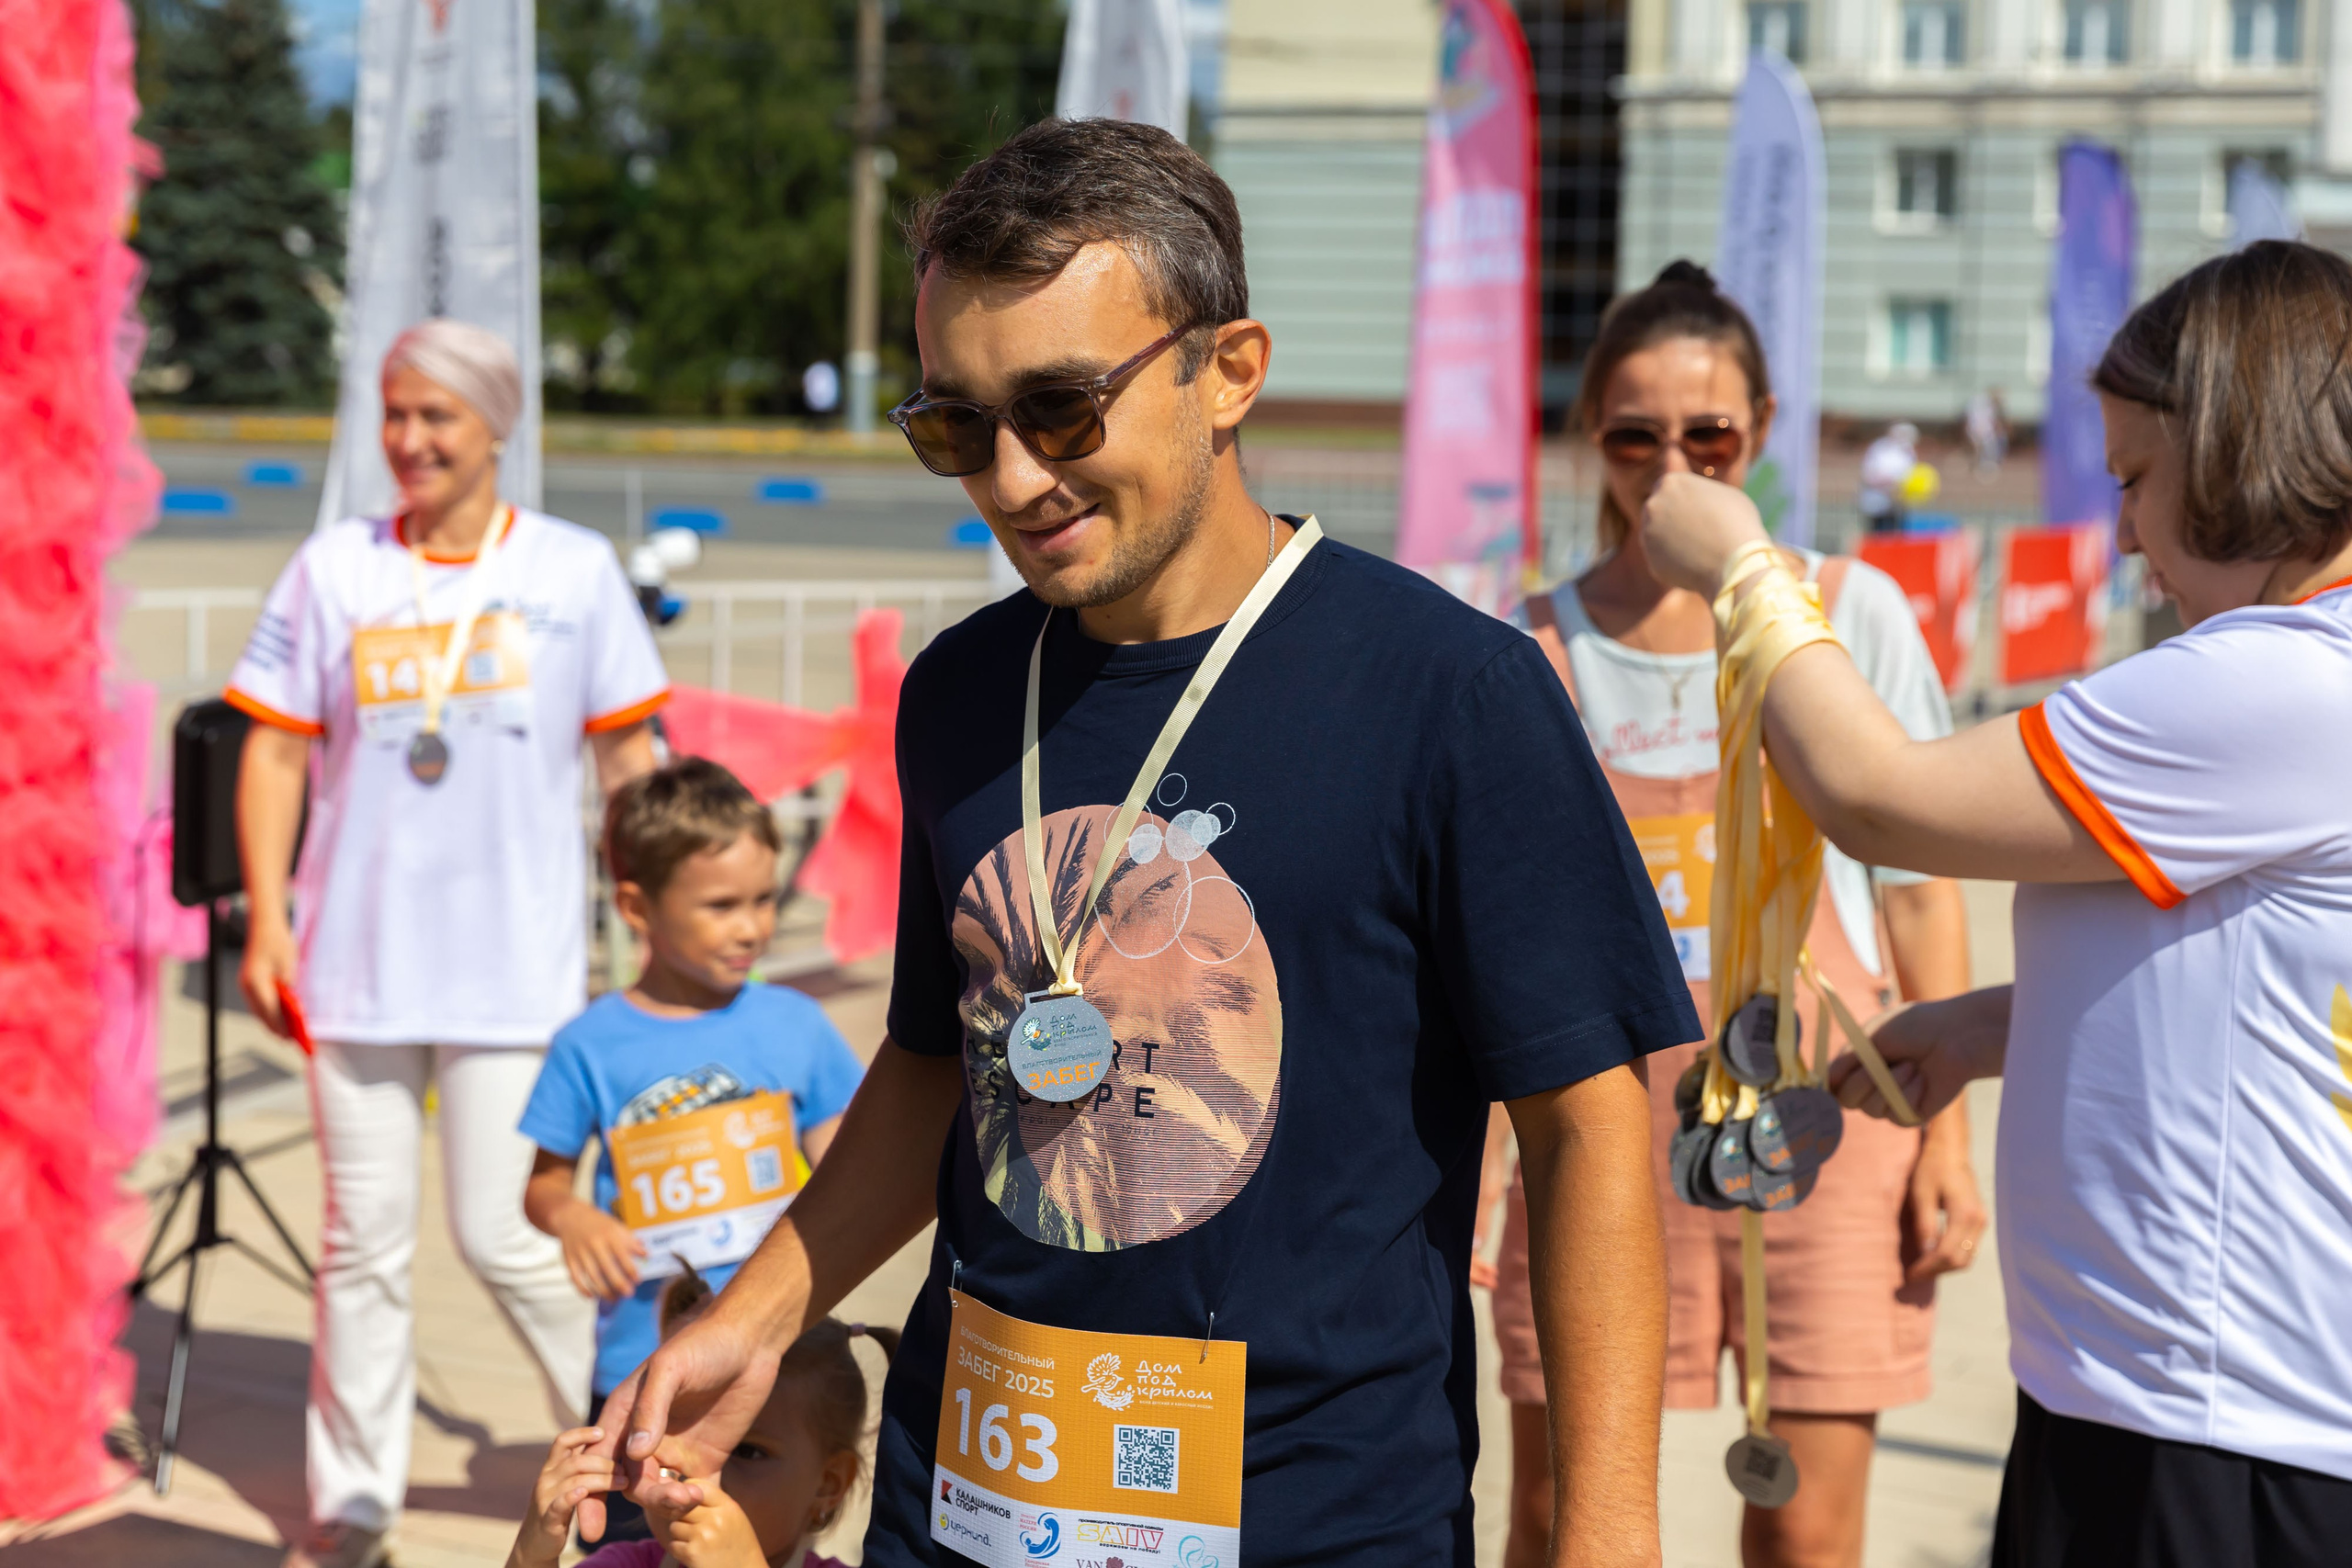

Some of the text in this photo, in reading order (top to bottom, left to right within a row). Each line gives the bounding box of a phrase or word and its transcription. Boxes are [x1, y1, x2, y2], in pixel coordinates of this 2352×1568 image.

[1027, 1062, 1101, 1090] ЗАБЕГ
[631, 1158, 726, 1218] 165
[960, 1325, 1055, 1371] БЛАГОТВОРИТЕЛЬНЫЙ
[957, 1346, 1055, 1398] ЗАБЕГ 2025
[1135, 1359, 1182, 1376] Дом
[1136, 1374, 1176, 1387] под
[1136, 1386, 1213, 1400] крылом
[955, 1387, 1059, 1483] 163
[956, 1487, 1011, 1519] КАЛАШНИКОВ
[956, 1497, 979, 1516] СПОРТ
